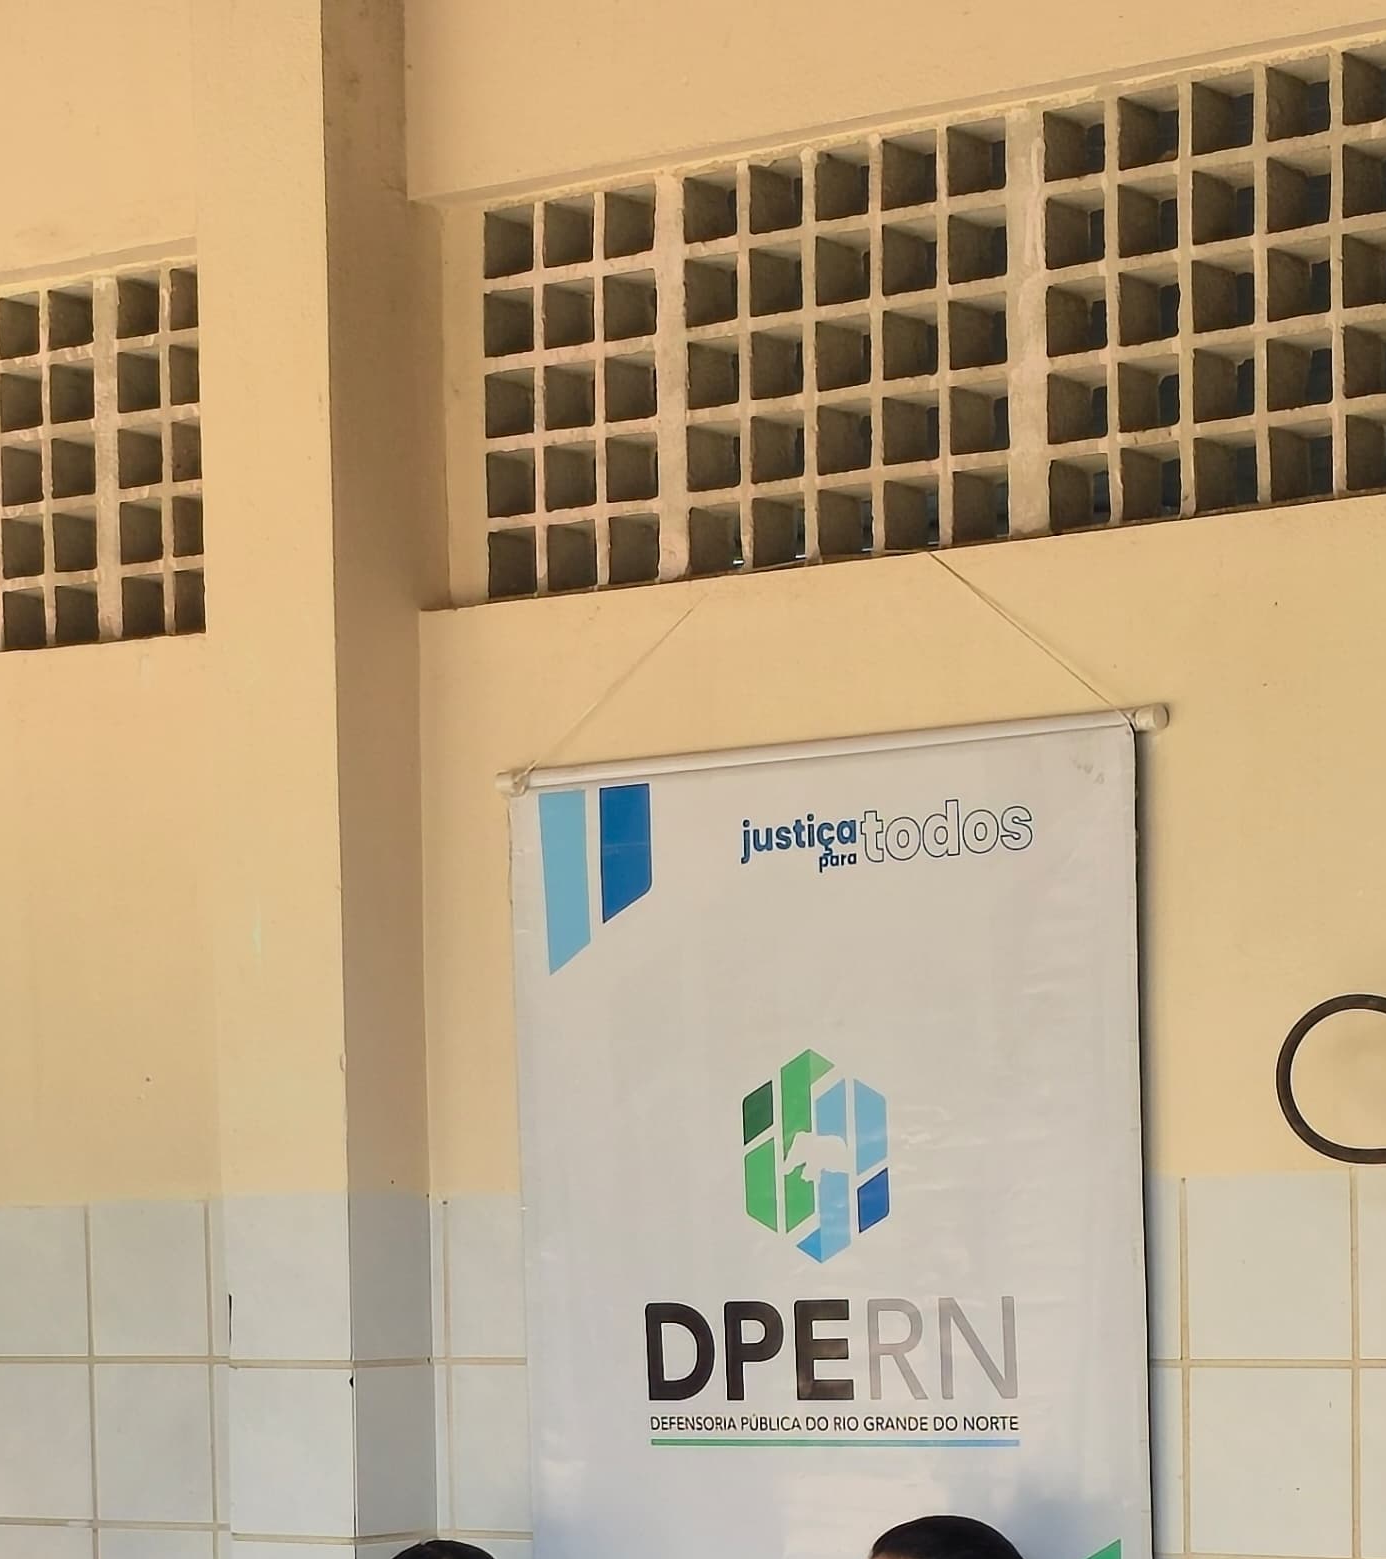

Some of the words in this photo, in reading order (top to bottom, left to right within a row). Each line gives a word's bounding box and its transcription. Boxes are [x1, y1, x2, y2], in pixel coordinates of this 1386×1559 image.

[741, 814, 857, 864] justiça
[819, 852, 857, 873] para
[861, 799, 1033, 863] todos
[645, 1296, 1018, 1401] DPERN
[650, 1417, 737, 1431] DEFENSORIA
[741, 1413, 801, 1431] PÚBLICA
[805, 1416, 829, 1431] DO
[833, 1416, 859, 1431] RIO
[863, 1416, 928, 1431] GRANDE
[933, 1416, 958, 1431] DO
[963, 1415, 1019, 1431] NORTE
